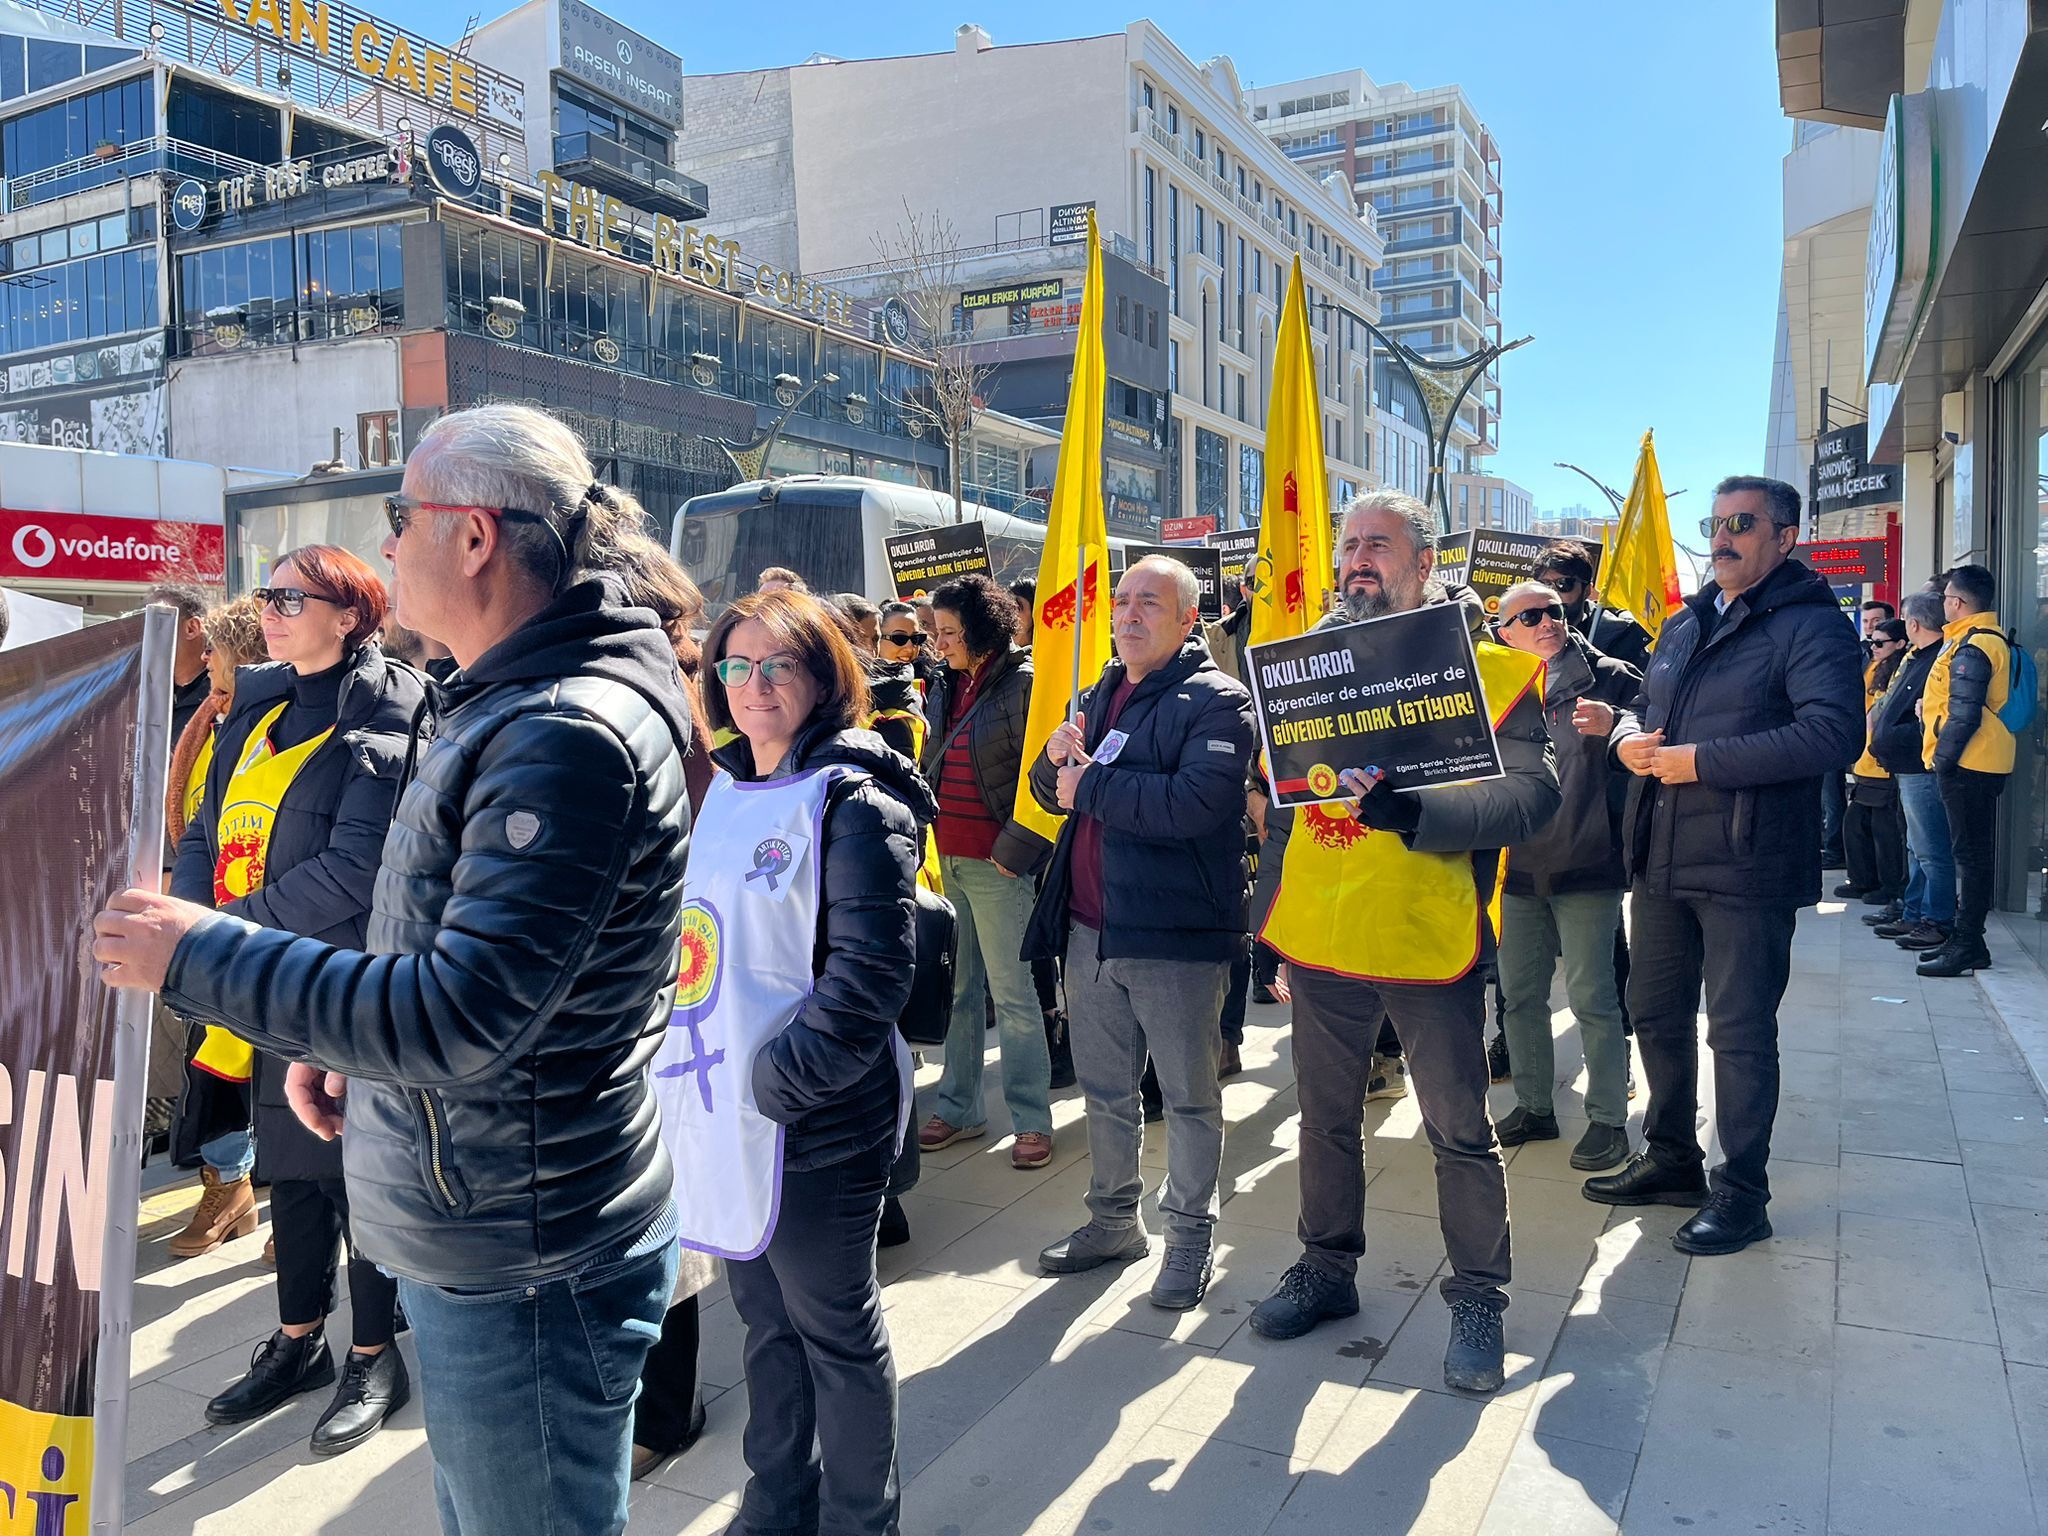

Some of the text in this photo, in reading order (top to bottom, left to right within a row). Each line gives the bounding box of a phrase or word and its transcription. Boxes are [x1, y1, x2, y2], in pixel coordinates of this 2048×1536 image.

[352, 21, 477, 115] CAFE
[443, 143, 475, 183] Rest
[218, 153, 389, 212] THE REST COFFEE
[182, 195, 203, 216] Rest
[1052, 215, 1089, 227] ALTINBA
[536, 169, 855, 328] THE REST COFFEE
[963, 293, 990, 308] ÖZLEM
[992, 290, 1019, 304] ERKEK
[51, 417, 90, 449] Rest
[1817, 438, 1843, 458] WAFLE
[1818, 457, 1853, 481] SANDVİÇ
[1817, 473, 1886, 500] SIKMA İÇECEK
[1164, 522, 1195, 532] UZUN 2.
[59, 536, 181, 563] vodafone
[890, 538, 936, 558] OKULLARDA
[893, 546, 984, 569] öğrenciler de emekçiler de
[1221, 554, 1245, 563] renciler
[1477, 539, 1538, 559] OKULLARDA
[896, 556, 987, 583] GÜVENDE OLMAK İSTİYOR!
[1221, 564, 1244, 577] VENDE
[1474, 557, 1533, 572] öğrenciler de
[1472, 569, 1512, 585] GÜVENDE
[1261, 649, 1355, 690] OKULLARDA
[1268, 666, 1466, 715] öğrenciler de emekçiler de
[1272, 691, 1476, 746] GÜVENDE OLMAK İSTİYOR!
[1396, 752, 1491, 774] Eğitim Sen'de Örgütlenelim
[1424, 760, 1493, 777] Birlikte Değiştirelim
[757, 840, 775, 854] ARTIK
[700, 923, 716, 953] SEN
